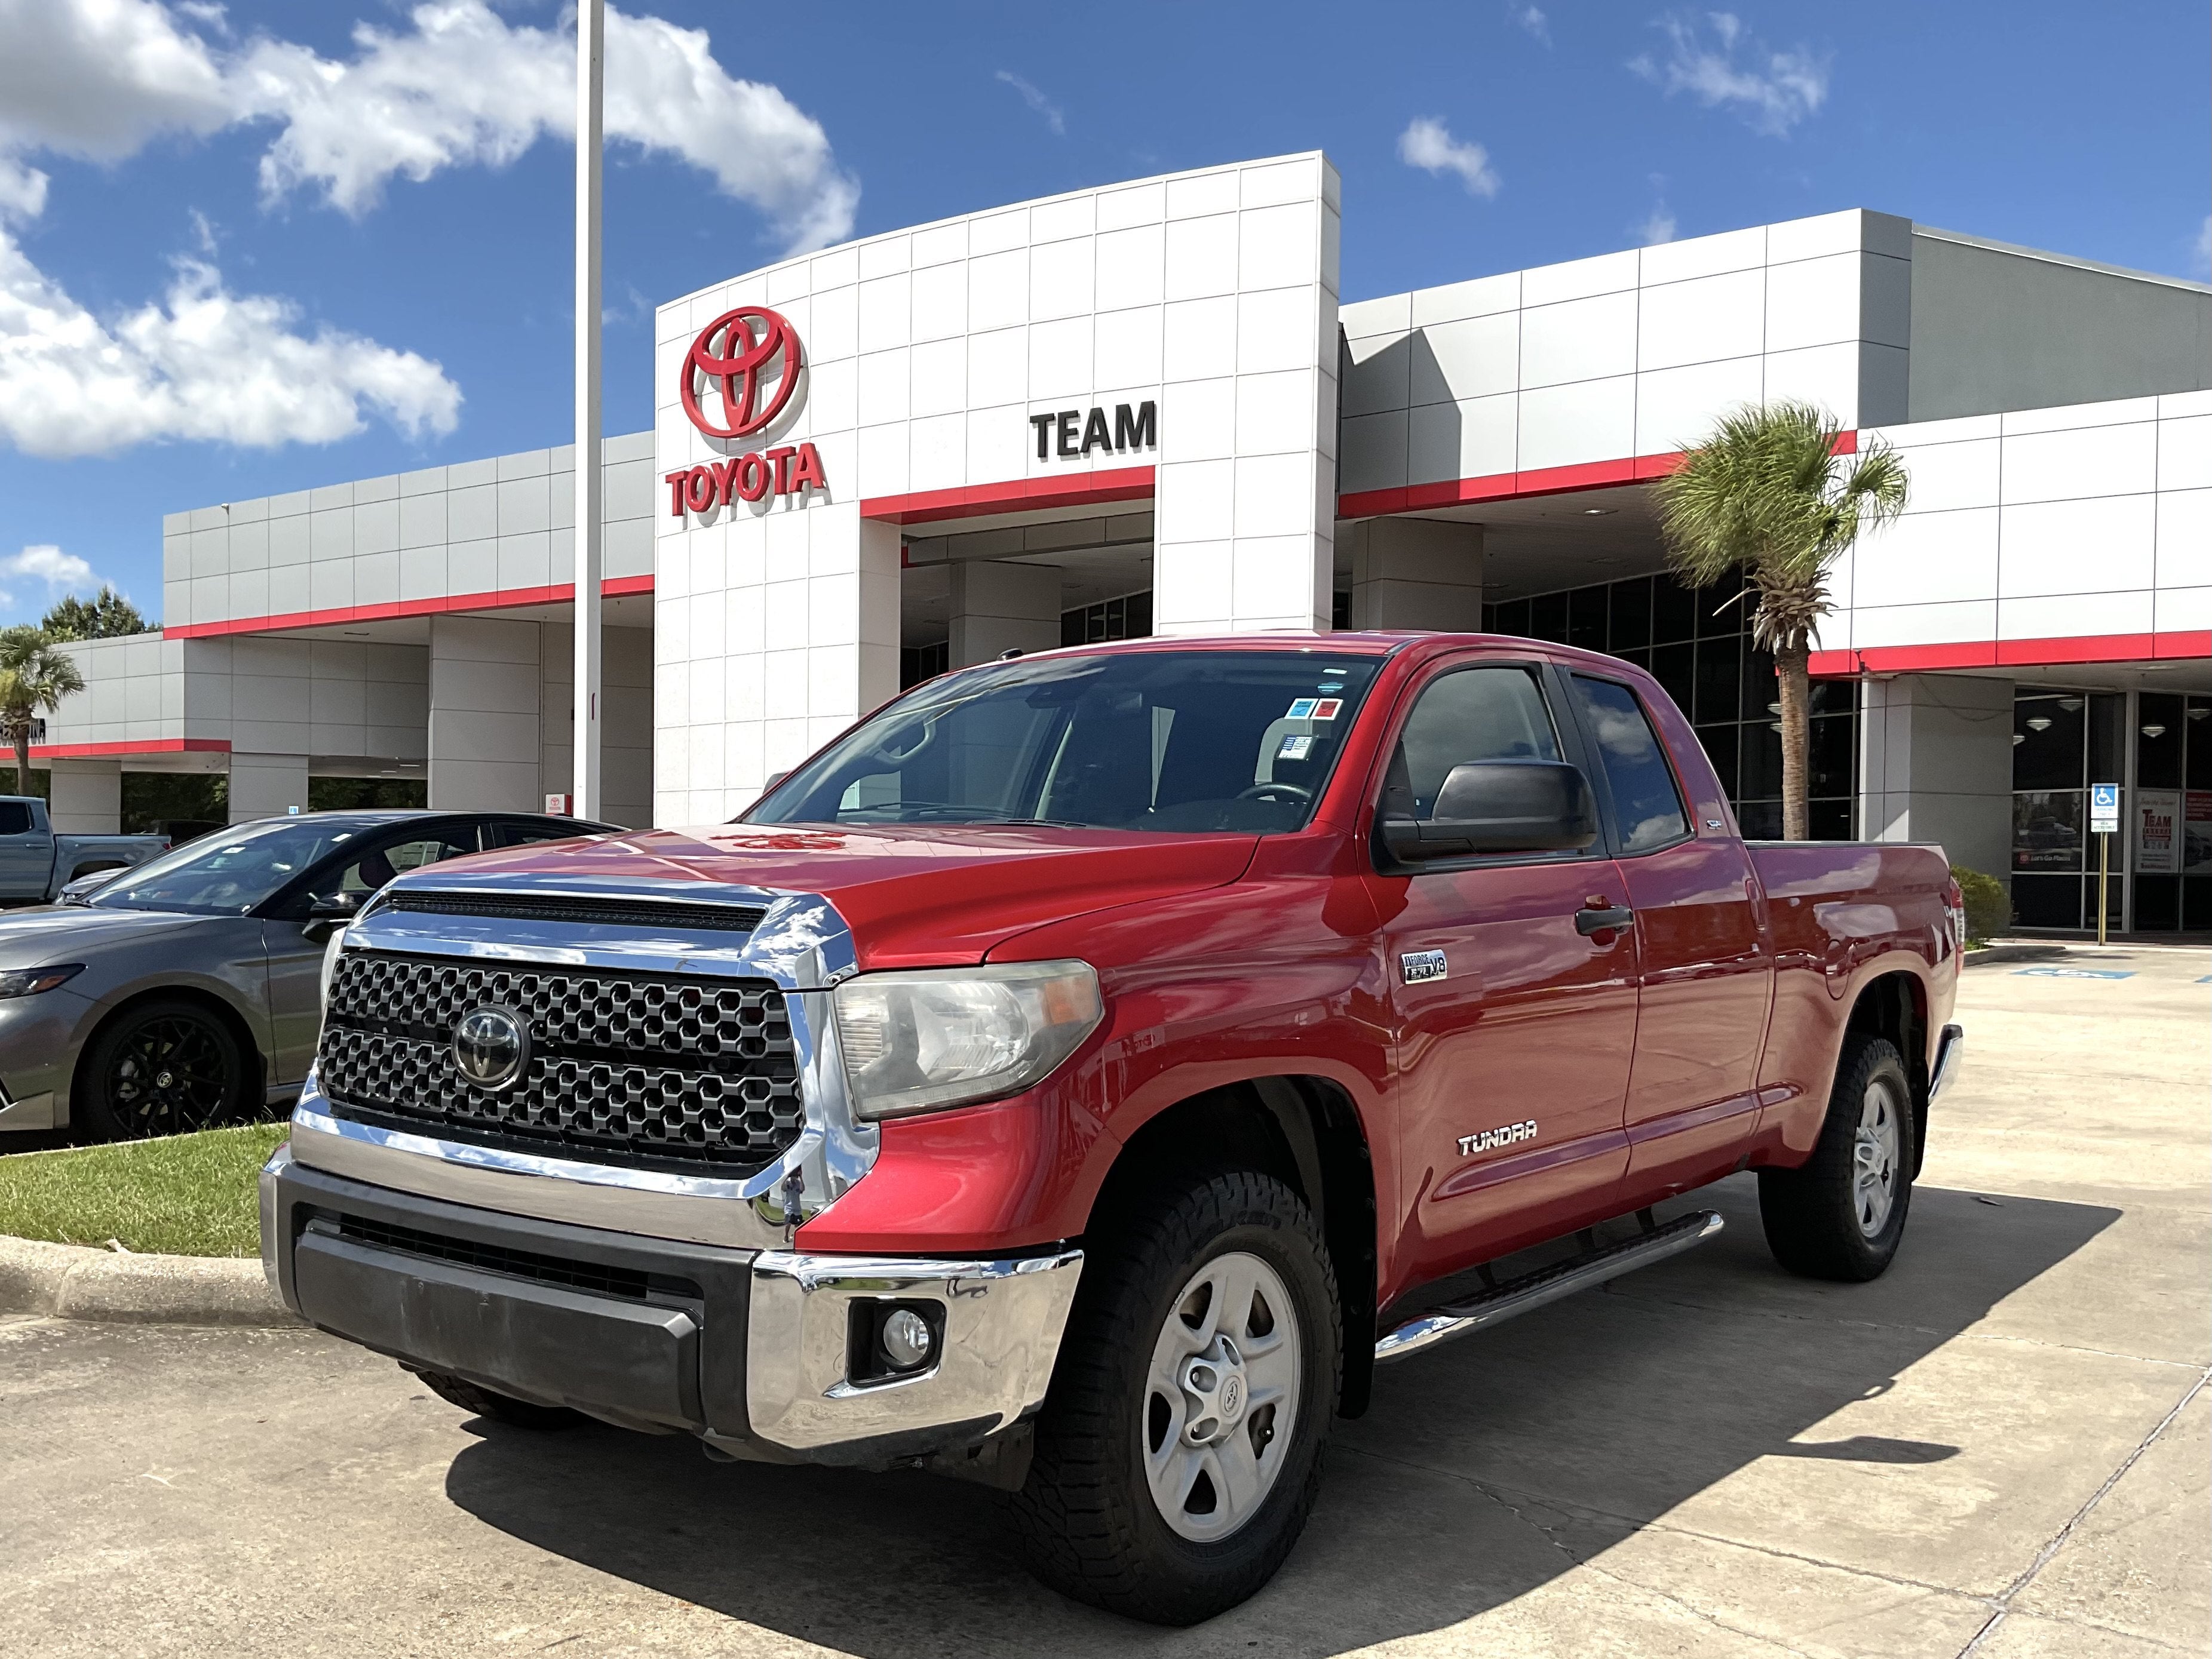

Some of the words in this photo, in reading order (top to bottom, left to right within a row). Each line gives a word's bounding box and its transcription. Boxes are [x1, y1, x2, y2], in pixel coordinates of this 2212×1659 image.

[1029, 401, 1155, 458] TEAM
[665, 443, 825, 516] TOYOTA
[2142, 809, 2172, 828] TEAM
[1430, 957, 1446, 976] V8
[1458, 1120, 1538, 1156] TUNDRA
